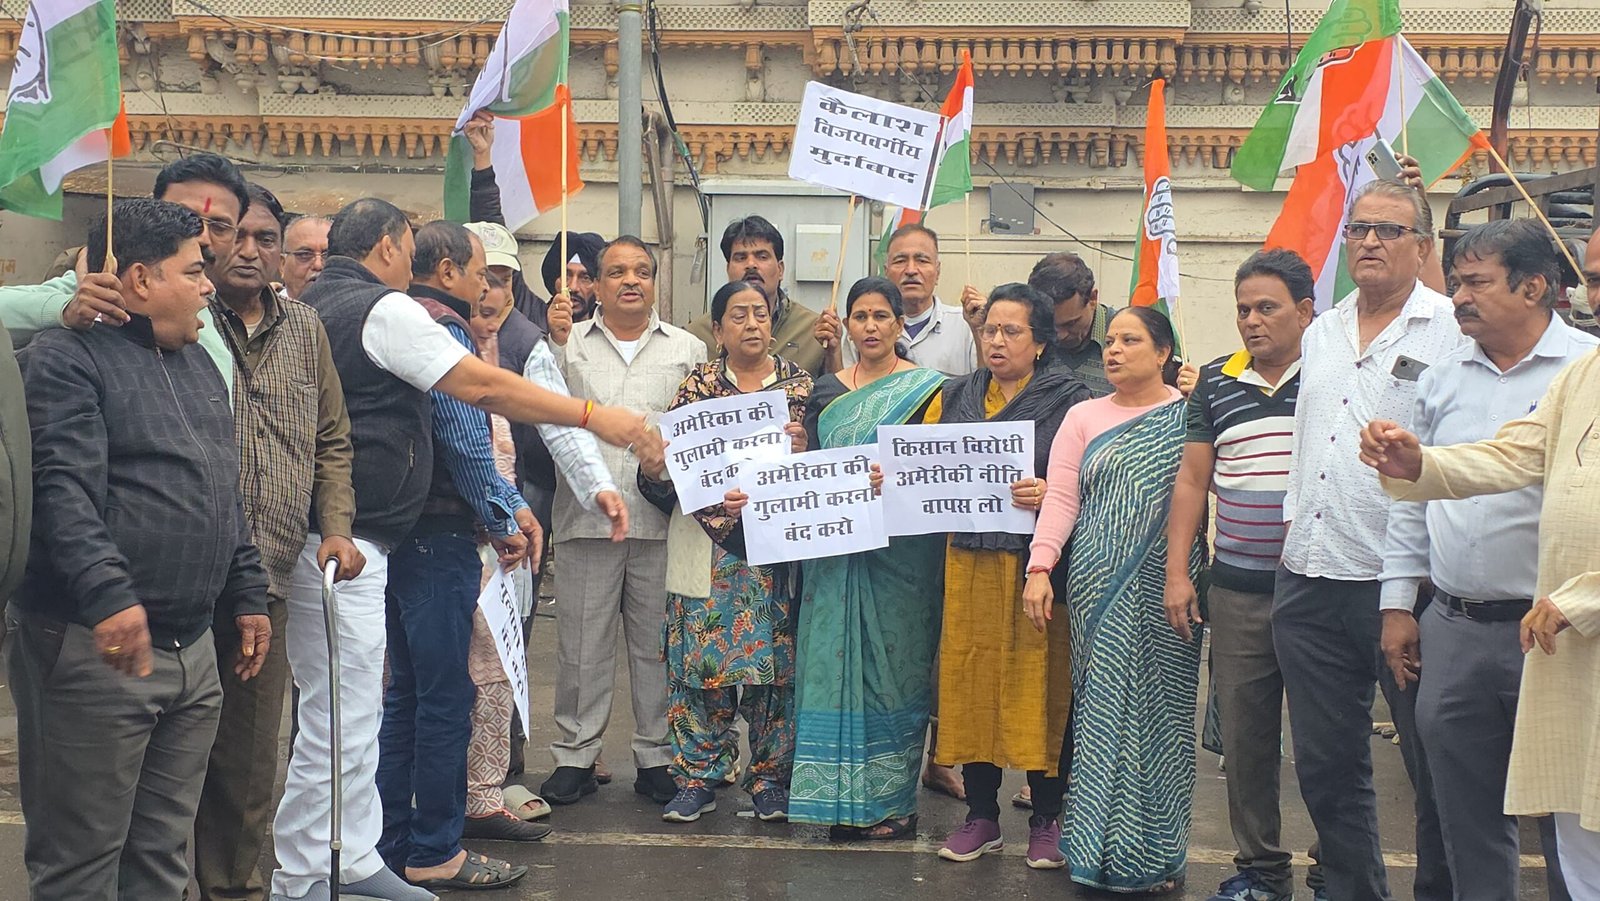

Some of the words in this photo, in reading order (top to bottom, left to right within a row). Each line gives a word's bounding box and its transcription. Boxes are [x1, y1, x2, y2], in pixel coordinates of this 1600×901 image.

[819, 97, 928, 137] कैलाश
[813, 117, 923, 160] विजयवर्गीय
[810, 145, 918, 184] मुर्दाबाद
[673, 411, 742, 437] अमेरिका
[747, 401, 774, 421] की
[673, 437, 727, 471] गुलामी
[731, 432, 783, 450] करना
[892, 438, 957, 457] किसान
[962, 434, 1024, 454] विरोधी
[700, 470, 723, 488] बंद
[757, 462, 837, 486] अमेरिका
[842, 455, 871, 475] की
[896, 463, 974, 487] अमेरीकी
[978, 464, 1024, 484] नीति
[753, 490, 820, 521] गुलामी
[825, 487, 877, 507] करना
[921, 498, 973, 514] वापस
[977, 494, 1004, 513] लो
[784, 522, 812, 541] बंद
[816, 516, 854, 538] करो
